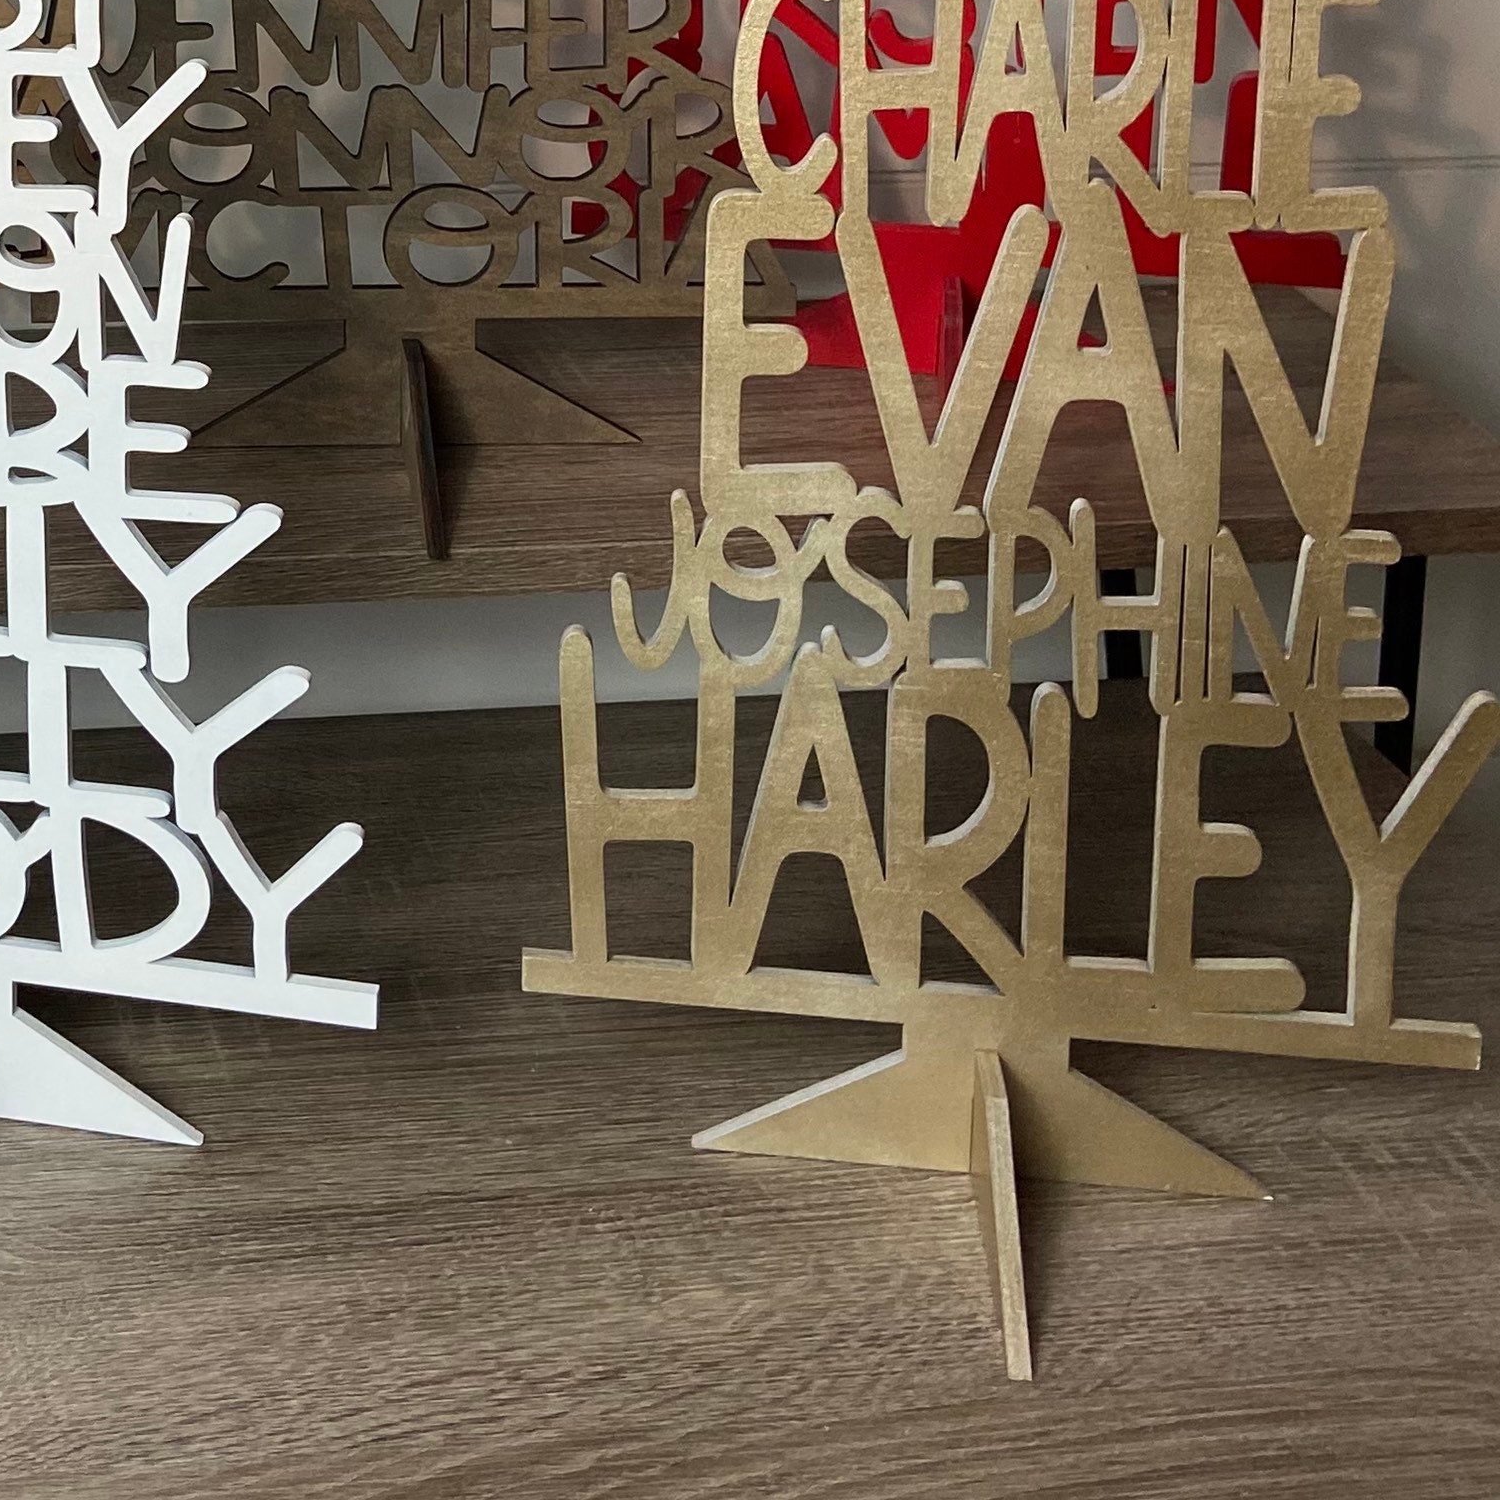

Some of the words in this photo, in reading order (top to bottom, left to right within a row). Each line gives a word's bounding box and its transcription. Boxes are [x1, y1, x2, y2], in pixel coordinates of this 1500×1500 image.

[700, 178, 1394, 536] EVAN
[610, 486, 1409, 719] JOSEPHINE
[559, 623, 1499, 1025] HARLEY
